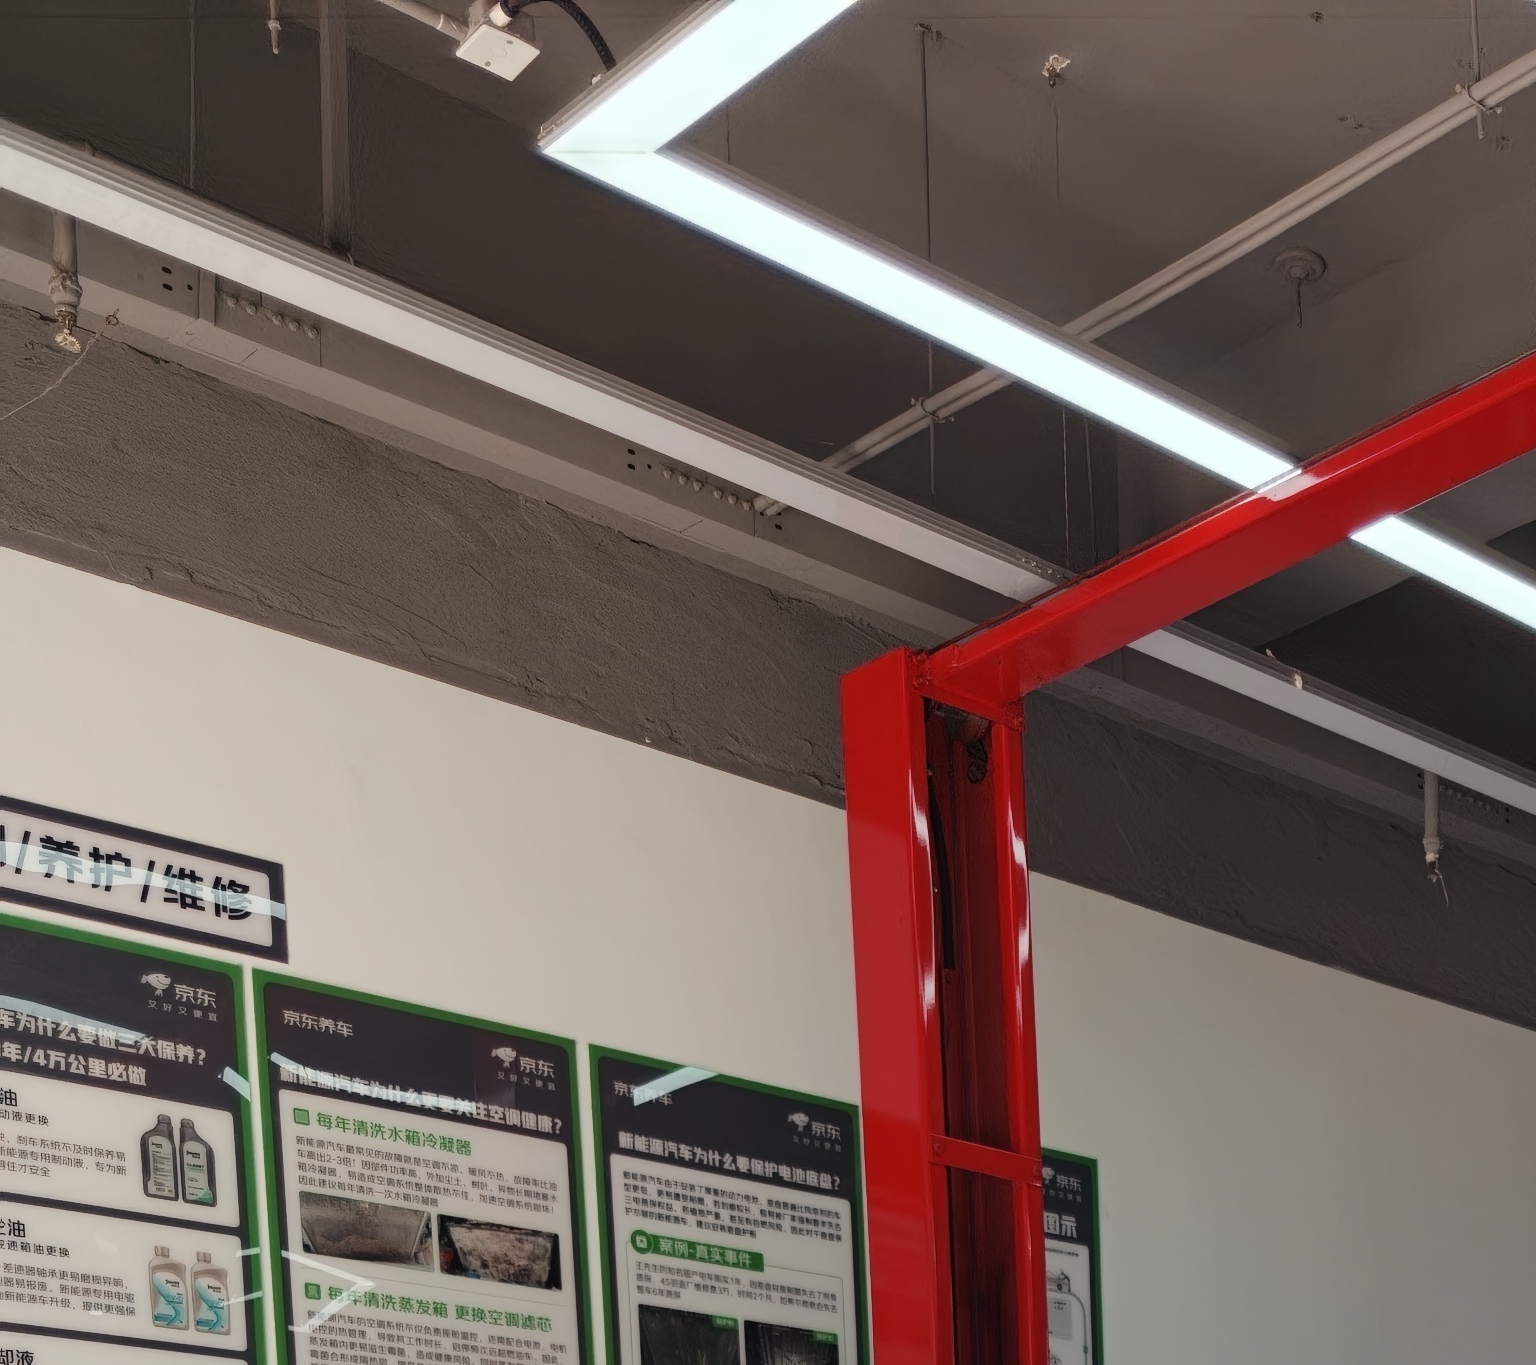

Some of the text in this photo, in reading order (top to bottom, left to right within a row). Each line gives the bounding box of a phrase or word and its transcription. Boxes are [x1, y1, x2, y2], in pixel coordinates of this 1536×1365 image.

[0, 825, 252, 920] /养护/维修
[174, 983, 216, 1009] 京东
[282, 1009, 353, 1037] 京东养车
[0, 1040, 146, 1087] 年/4万公里必做
[519, 1056, 555, 1079] 京东
[316, 1112, 472, 1156] 每年清洗水箱冷凝器
[811, 1120, 841, 1142] 京东
[1056, 1174, 1082, 1193] 京东
[328, 1285, 552, 1332] 每年清洗蒸发箱 更换空调滤芯
